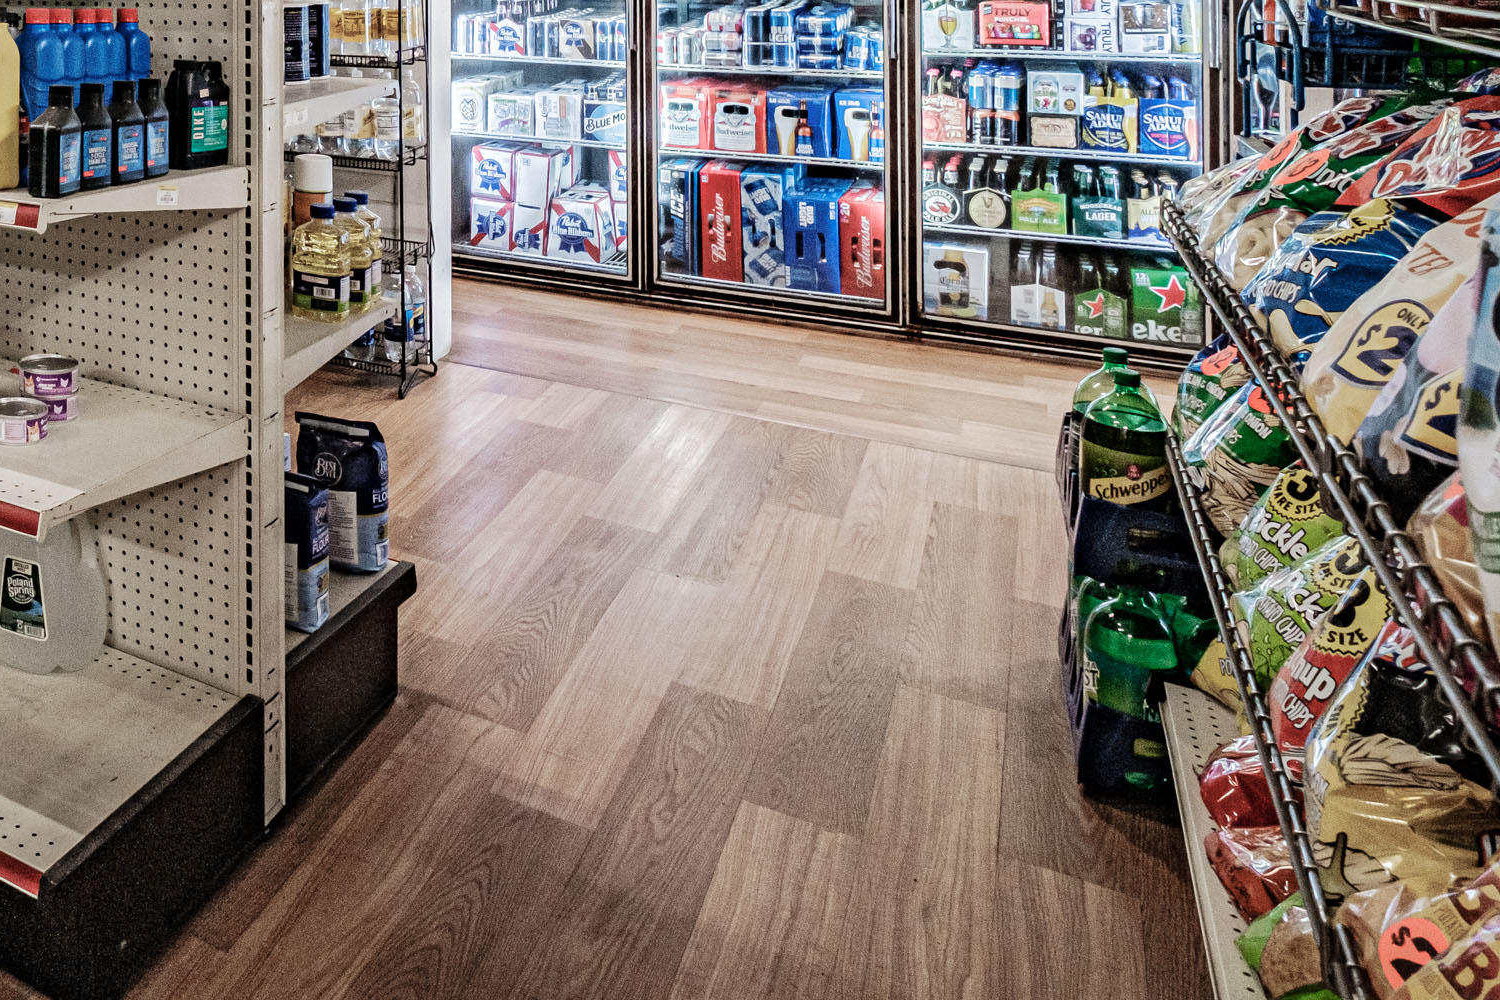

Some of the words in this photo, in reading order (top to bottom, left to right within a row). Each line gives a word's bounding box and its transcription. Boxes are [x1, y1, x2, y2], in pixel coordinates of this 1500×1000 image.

[994, 7, 1031, 17] TRULY
[1100, 22, 1111, 53] TRULY
[586, 115, 611, 132] BLUE
[670, 190, 684, 218] ICE
[561, 216, 581, 226] Pabst
[799, 202, 807, 227] LIGHT
[806, 205, 815, 225] BUD
[1018, 215, 1036, 224] PALE
[1042, 217, 1058, 225] ALE
[1085, 212, 1117, 222] LAGER
[711, 193, 727, 263] Budweiser
[856, 215, 873, 288] Budweiser
[1396, 307, 1430, 330] ONLY
[1095, 467, 1170, 500] Schweppes
[1296, 500, 1321, 515] SIZE
[7, 576, 34, 588] Poland
[8, 586, 35, 598] Spring
[1326, 626, 1369, 646] SIZE
[1282, 692, 1315, 729] CHIPS
